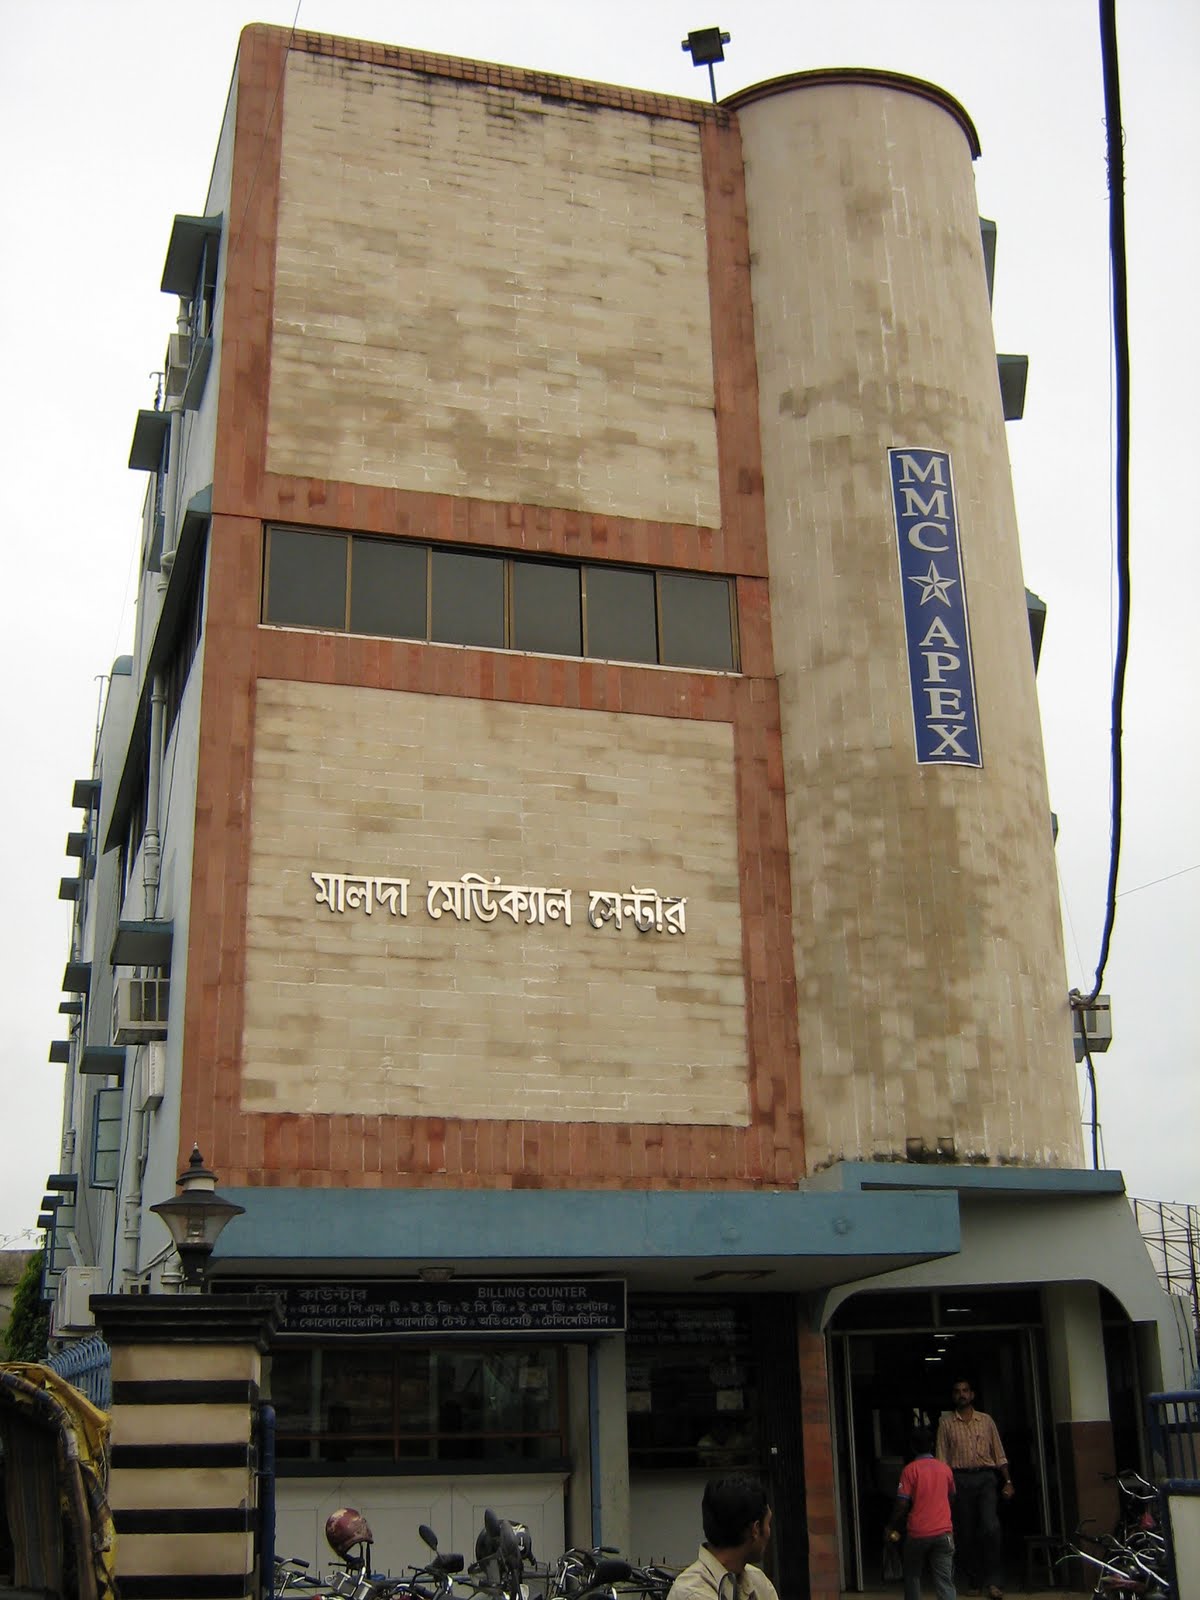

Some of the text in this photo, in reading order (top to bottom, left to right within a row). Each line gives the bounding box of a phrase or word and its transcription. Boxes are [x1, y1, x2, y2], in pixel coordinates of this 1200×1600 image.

[896, 454, 971, 758] MMC APEX
[311, 871, 688, 935] মালদা মেডিক্যাল সেন্টার
[297, 1286, 368, 1301] কাউন্টার
[478, 1286, 587, 1299] BILLING COUNTER
